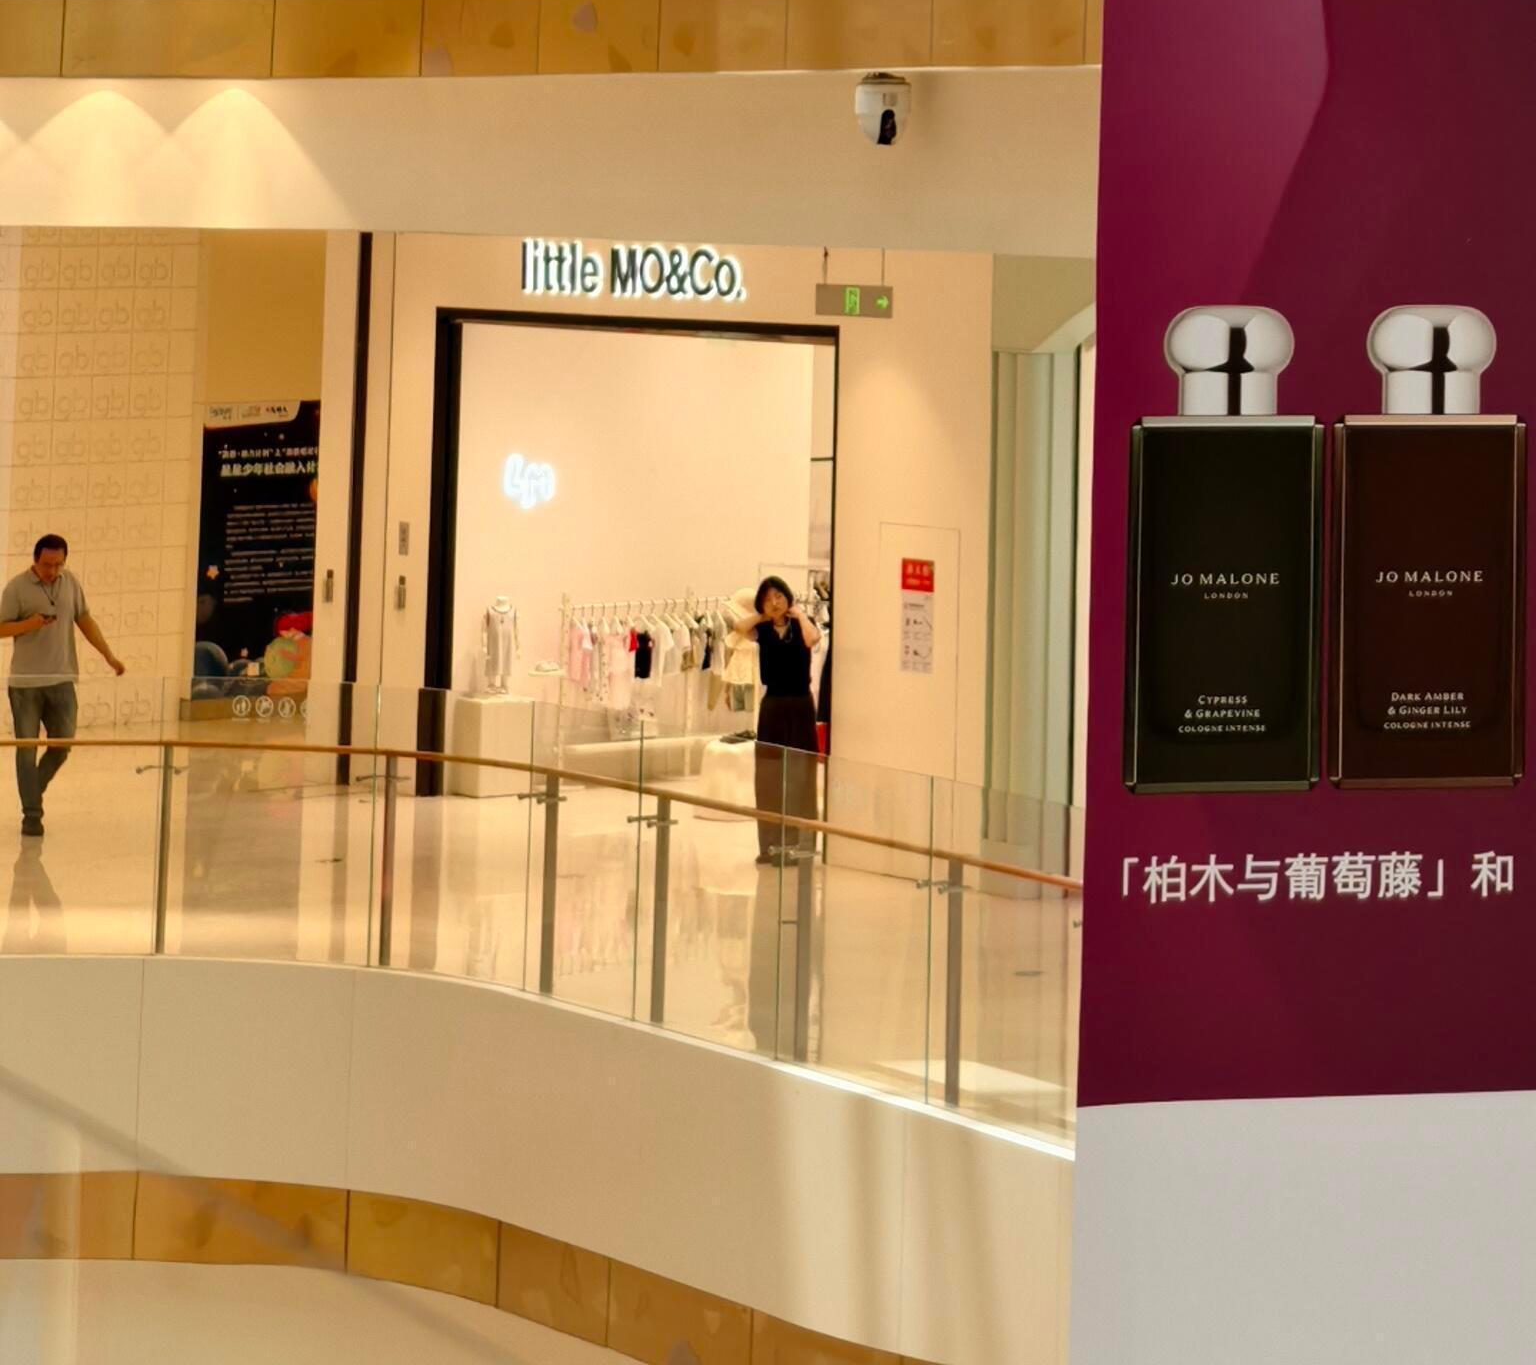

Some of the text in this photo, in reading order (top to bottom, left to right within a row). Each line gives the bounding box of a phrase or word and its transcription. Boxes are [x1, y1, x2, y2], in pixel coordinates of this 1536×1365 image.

[521, 238, 746, 302] little MO&Co.
[1170, 572, 1281, 586] JO MALONE
[1376, 570, 1484, 584] JO MALONE
[1203, 591, 1249, 600] LONDON
[1408, 589, 1454, 598] LONDON
[1121, 852, 1445, 904] 「柏木与葡萄藤」
[1470, 850, 1515, 898] 和
